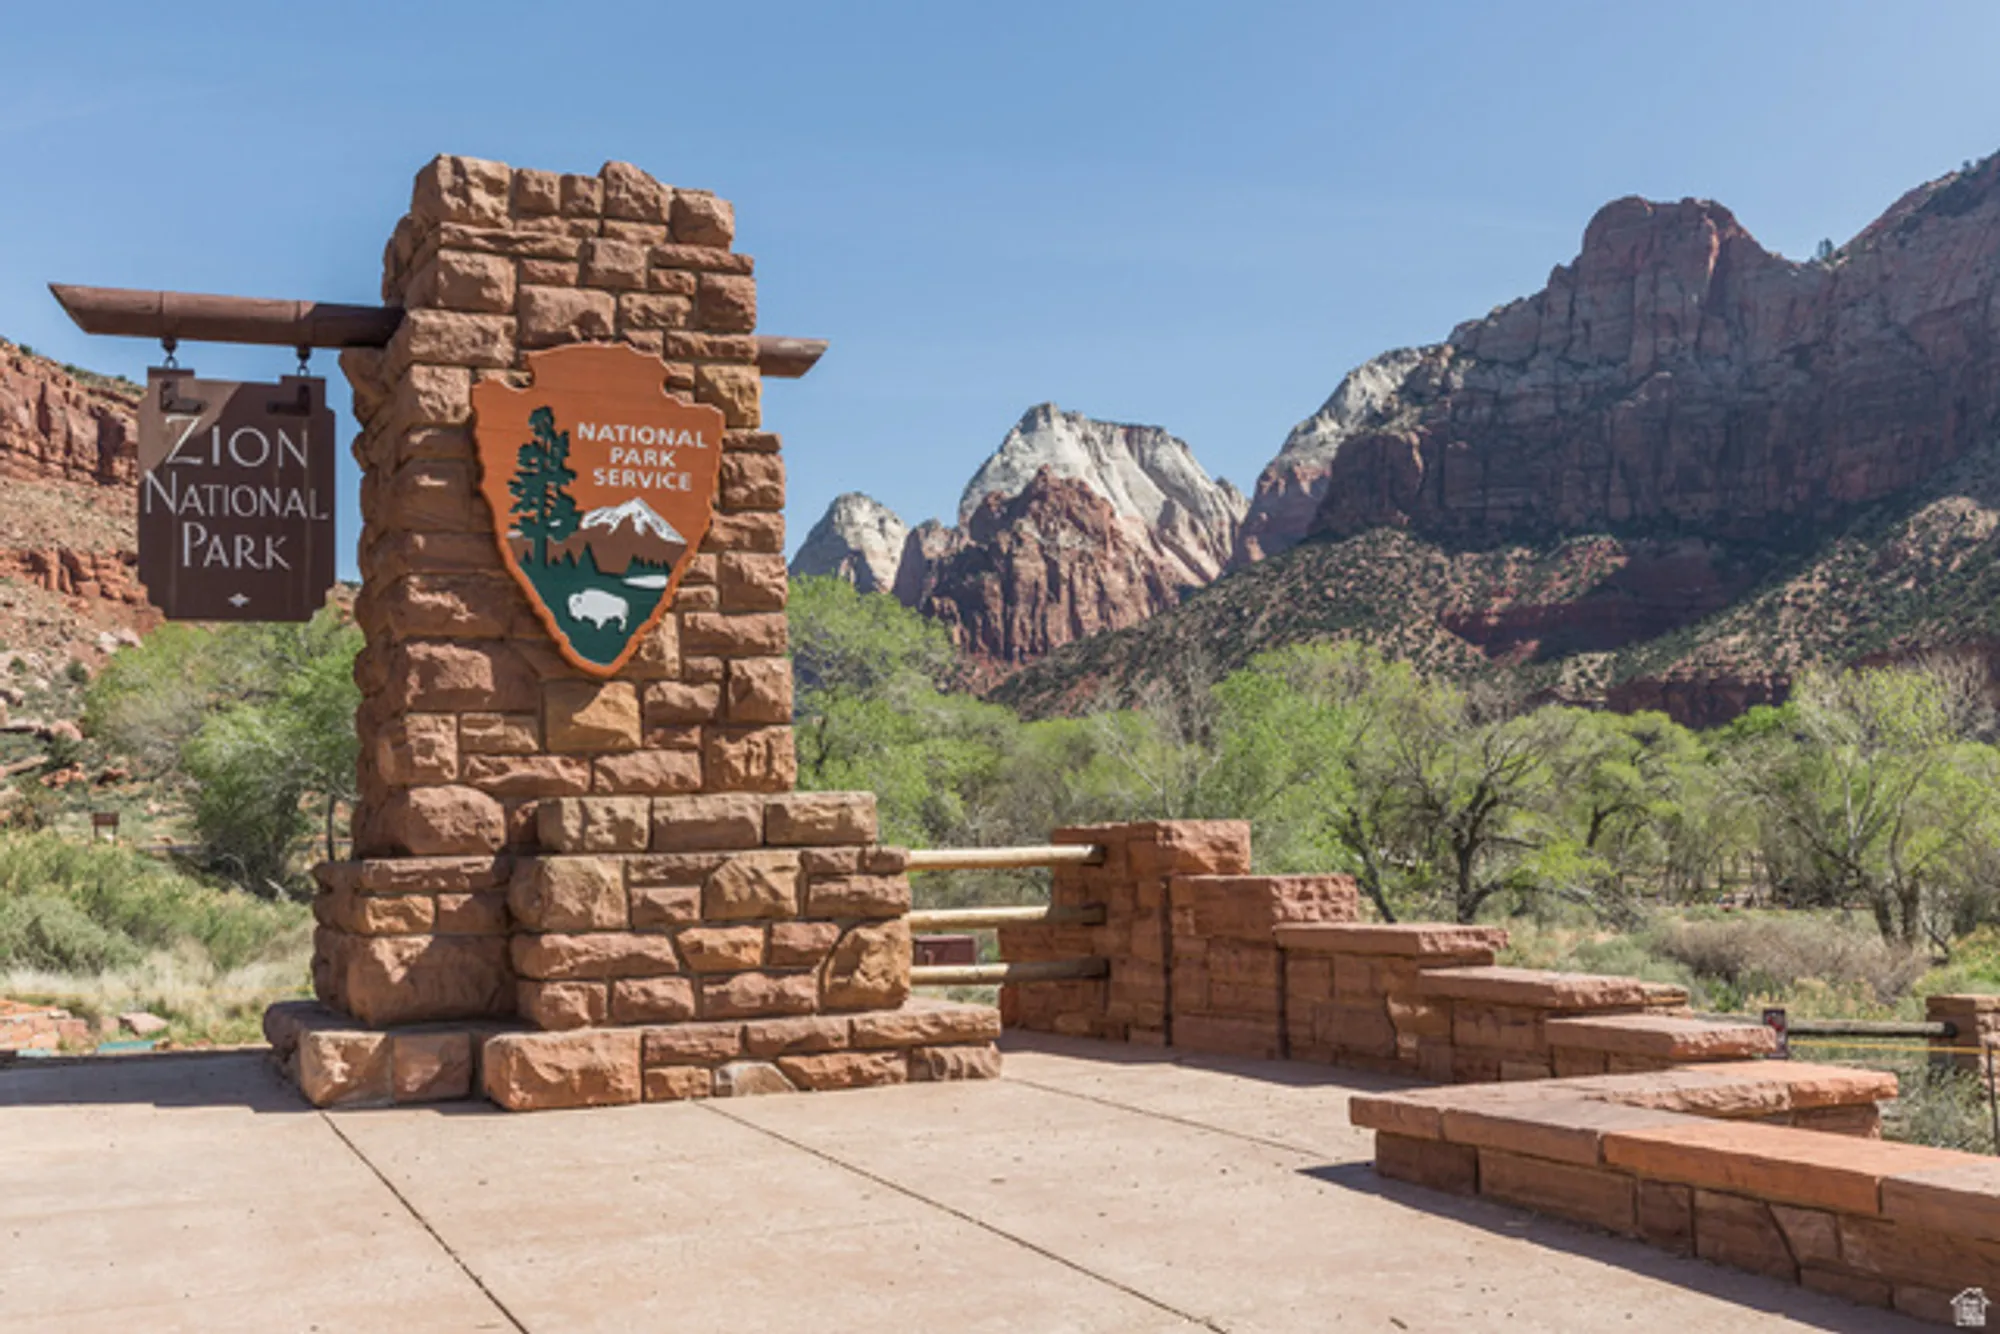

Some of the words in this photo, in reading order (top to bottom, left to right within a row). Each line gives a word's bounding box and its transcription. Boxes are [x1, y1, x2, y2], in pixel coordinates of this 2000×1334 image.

[166, 415, 308, 468] ZION
[578, 422, 707, 448] NATIONAL
[610, 447, 676, 467] PARK
[143, 468, 329, 521] NATIONAL
[593, 468, 692, 491] SERVICE
[182, 521, 291, 571] PARK
